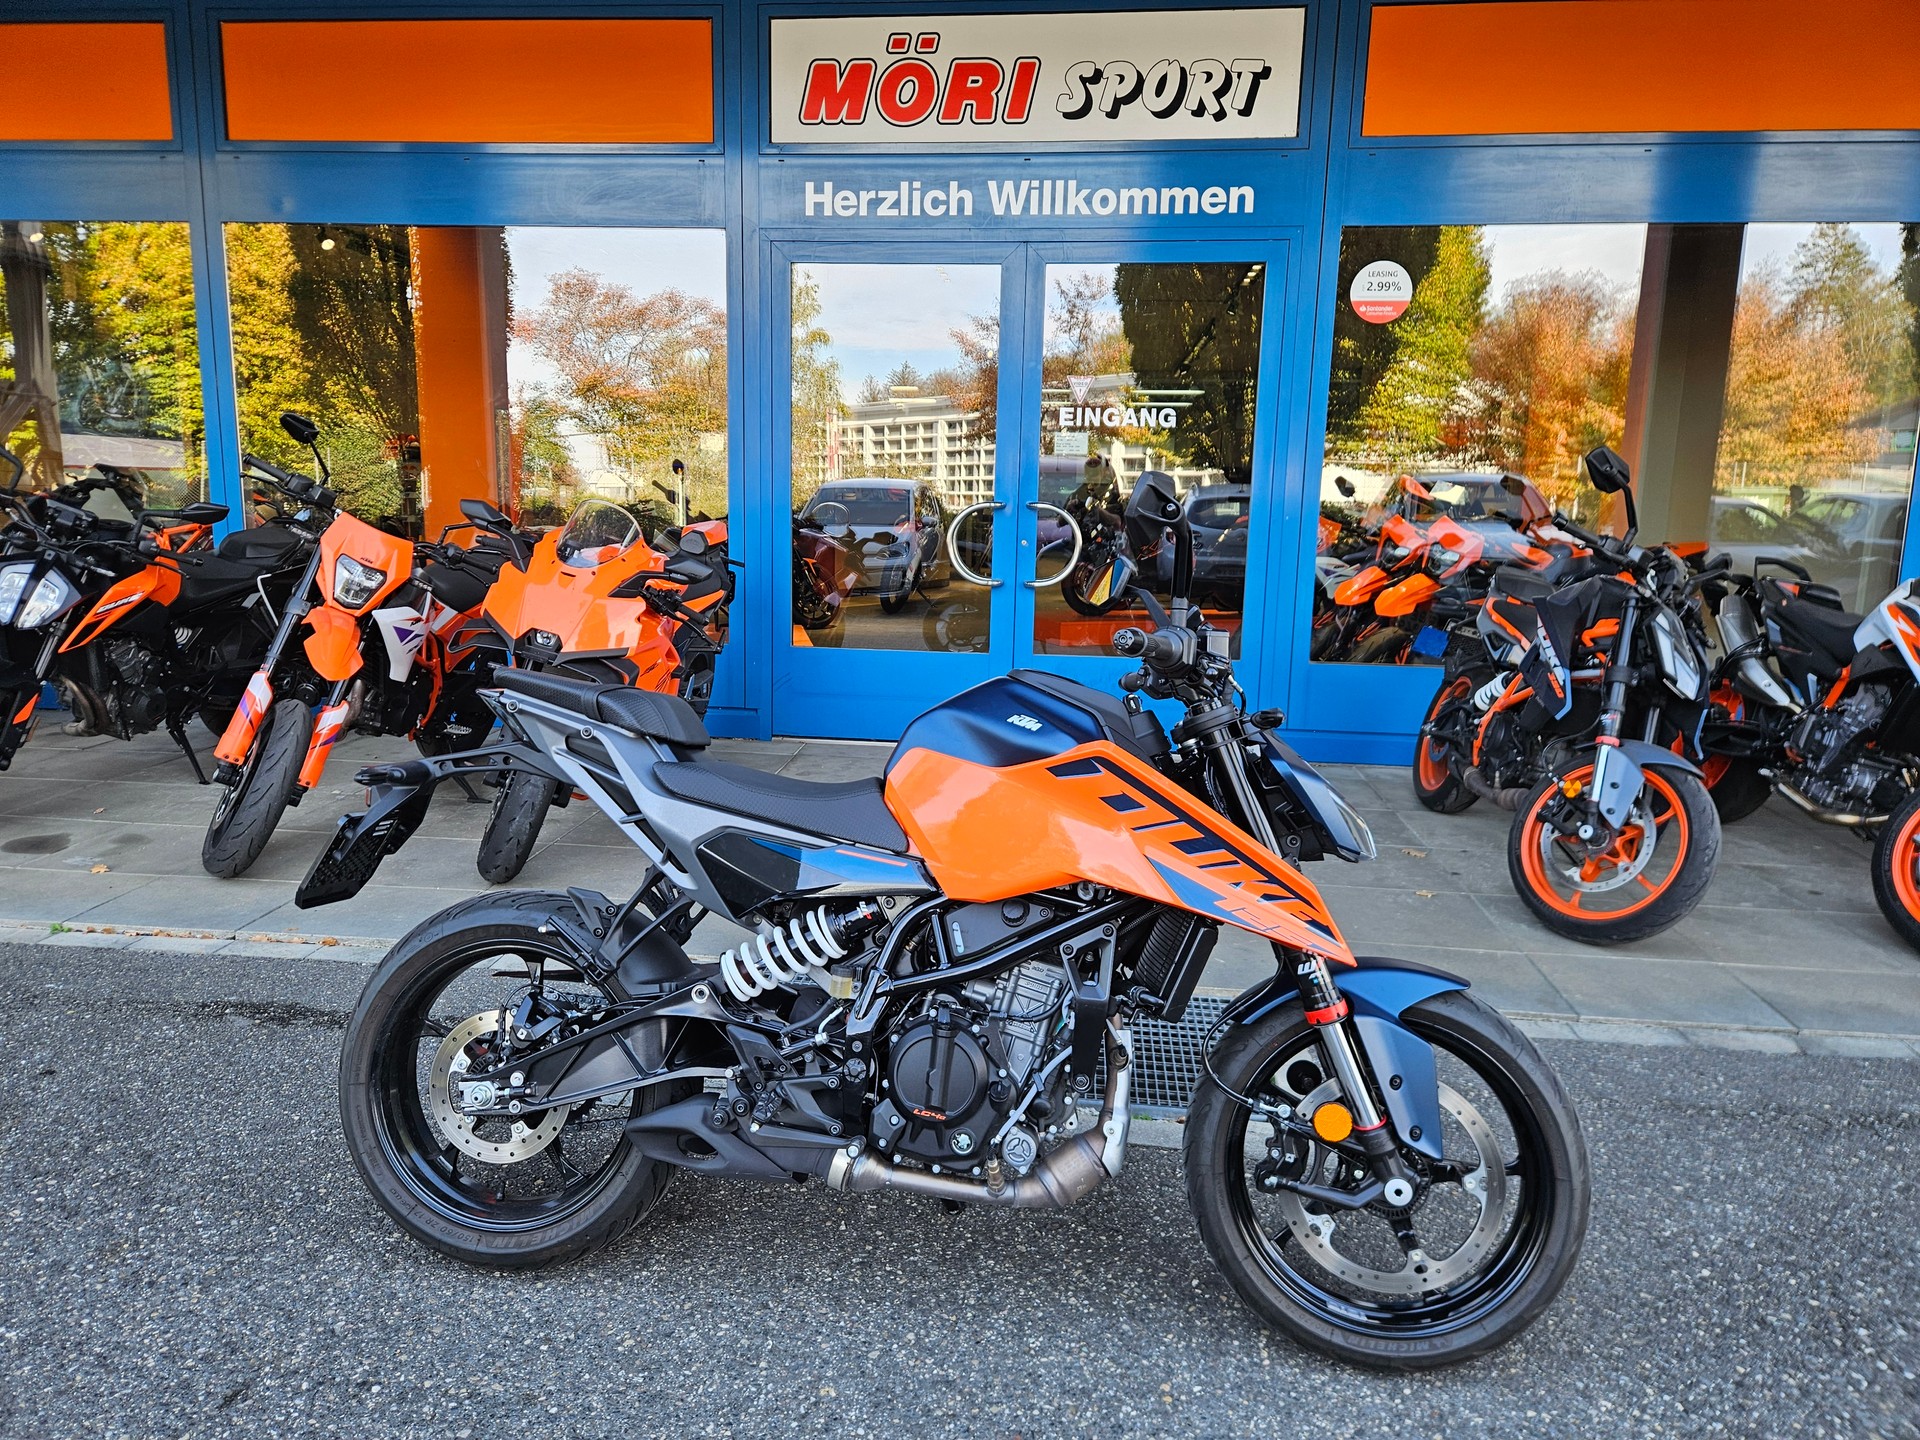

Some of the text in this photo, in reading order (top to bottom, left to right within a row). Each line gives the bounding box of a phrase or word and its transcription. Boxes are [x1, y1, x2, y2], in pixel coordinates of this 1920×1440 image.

[799, 32, 1272, 127] MÖRI SPORT
[805, 178, 1255, 217] Herzlich Willkommen
[1368, 270, 1399, 278] LEASING
[1366, 281, 1402, 292] 2.99%
[1059, 407, 1177, 428] EINGANG
[1006, 714, 1043, 732] KTM
[1057, 757, 1332, 936] DUKE
[425, 1218, 440, 1229] ZR
[491, 1207, 597, 1248] MICHELIN
[439, 1225, 473, 1242] 150/60
[1346, 1336, 1430, 1351] MICHELIN
